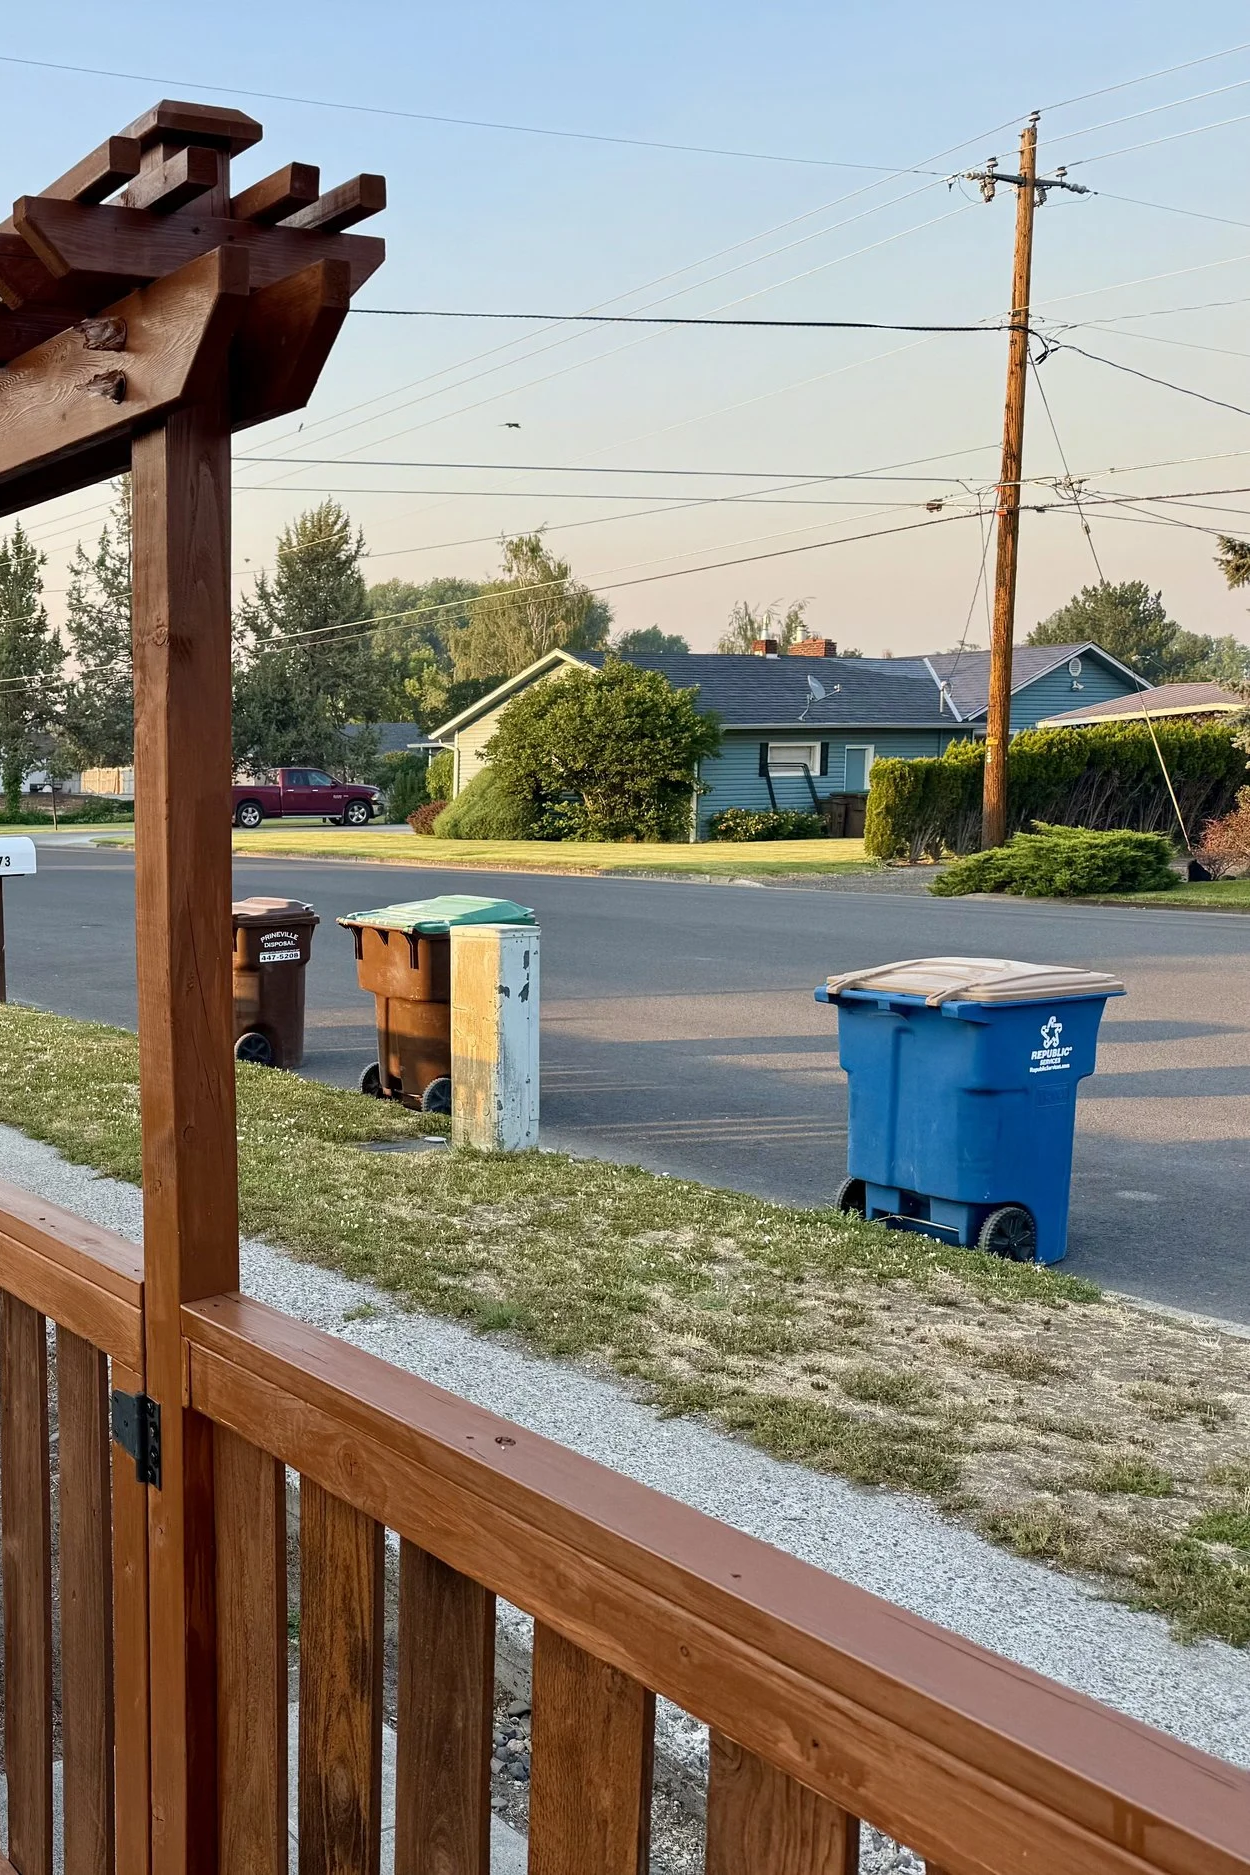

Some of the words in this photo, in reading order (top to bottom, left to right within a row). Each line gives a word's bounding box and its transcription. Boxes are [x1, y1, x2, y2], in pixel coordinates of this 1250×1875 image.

[260, 931, 299, 943] PRINEVILLE
[264, 940, 296, 948] DISPOSAL
[1031, 1047, 1071, 1060] REPUBLIC
